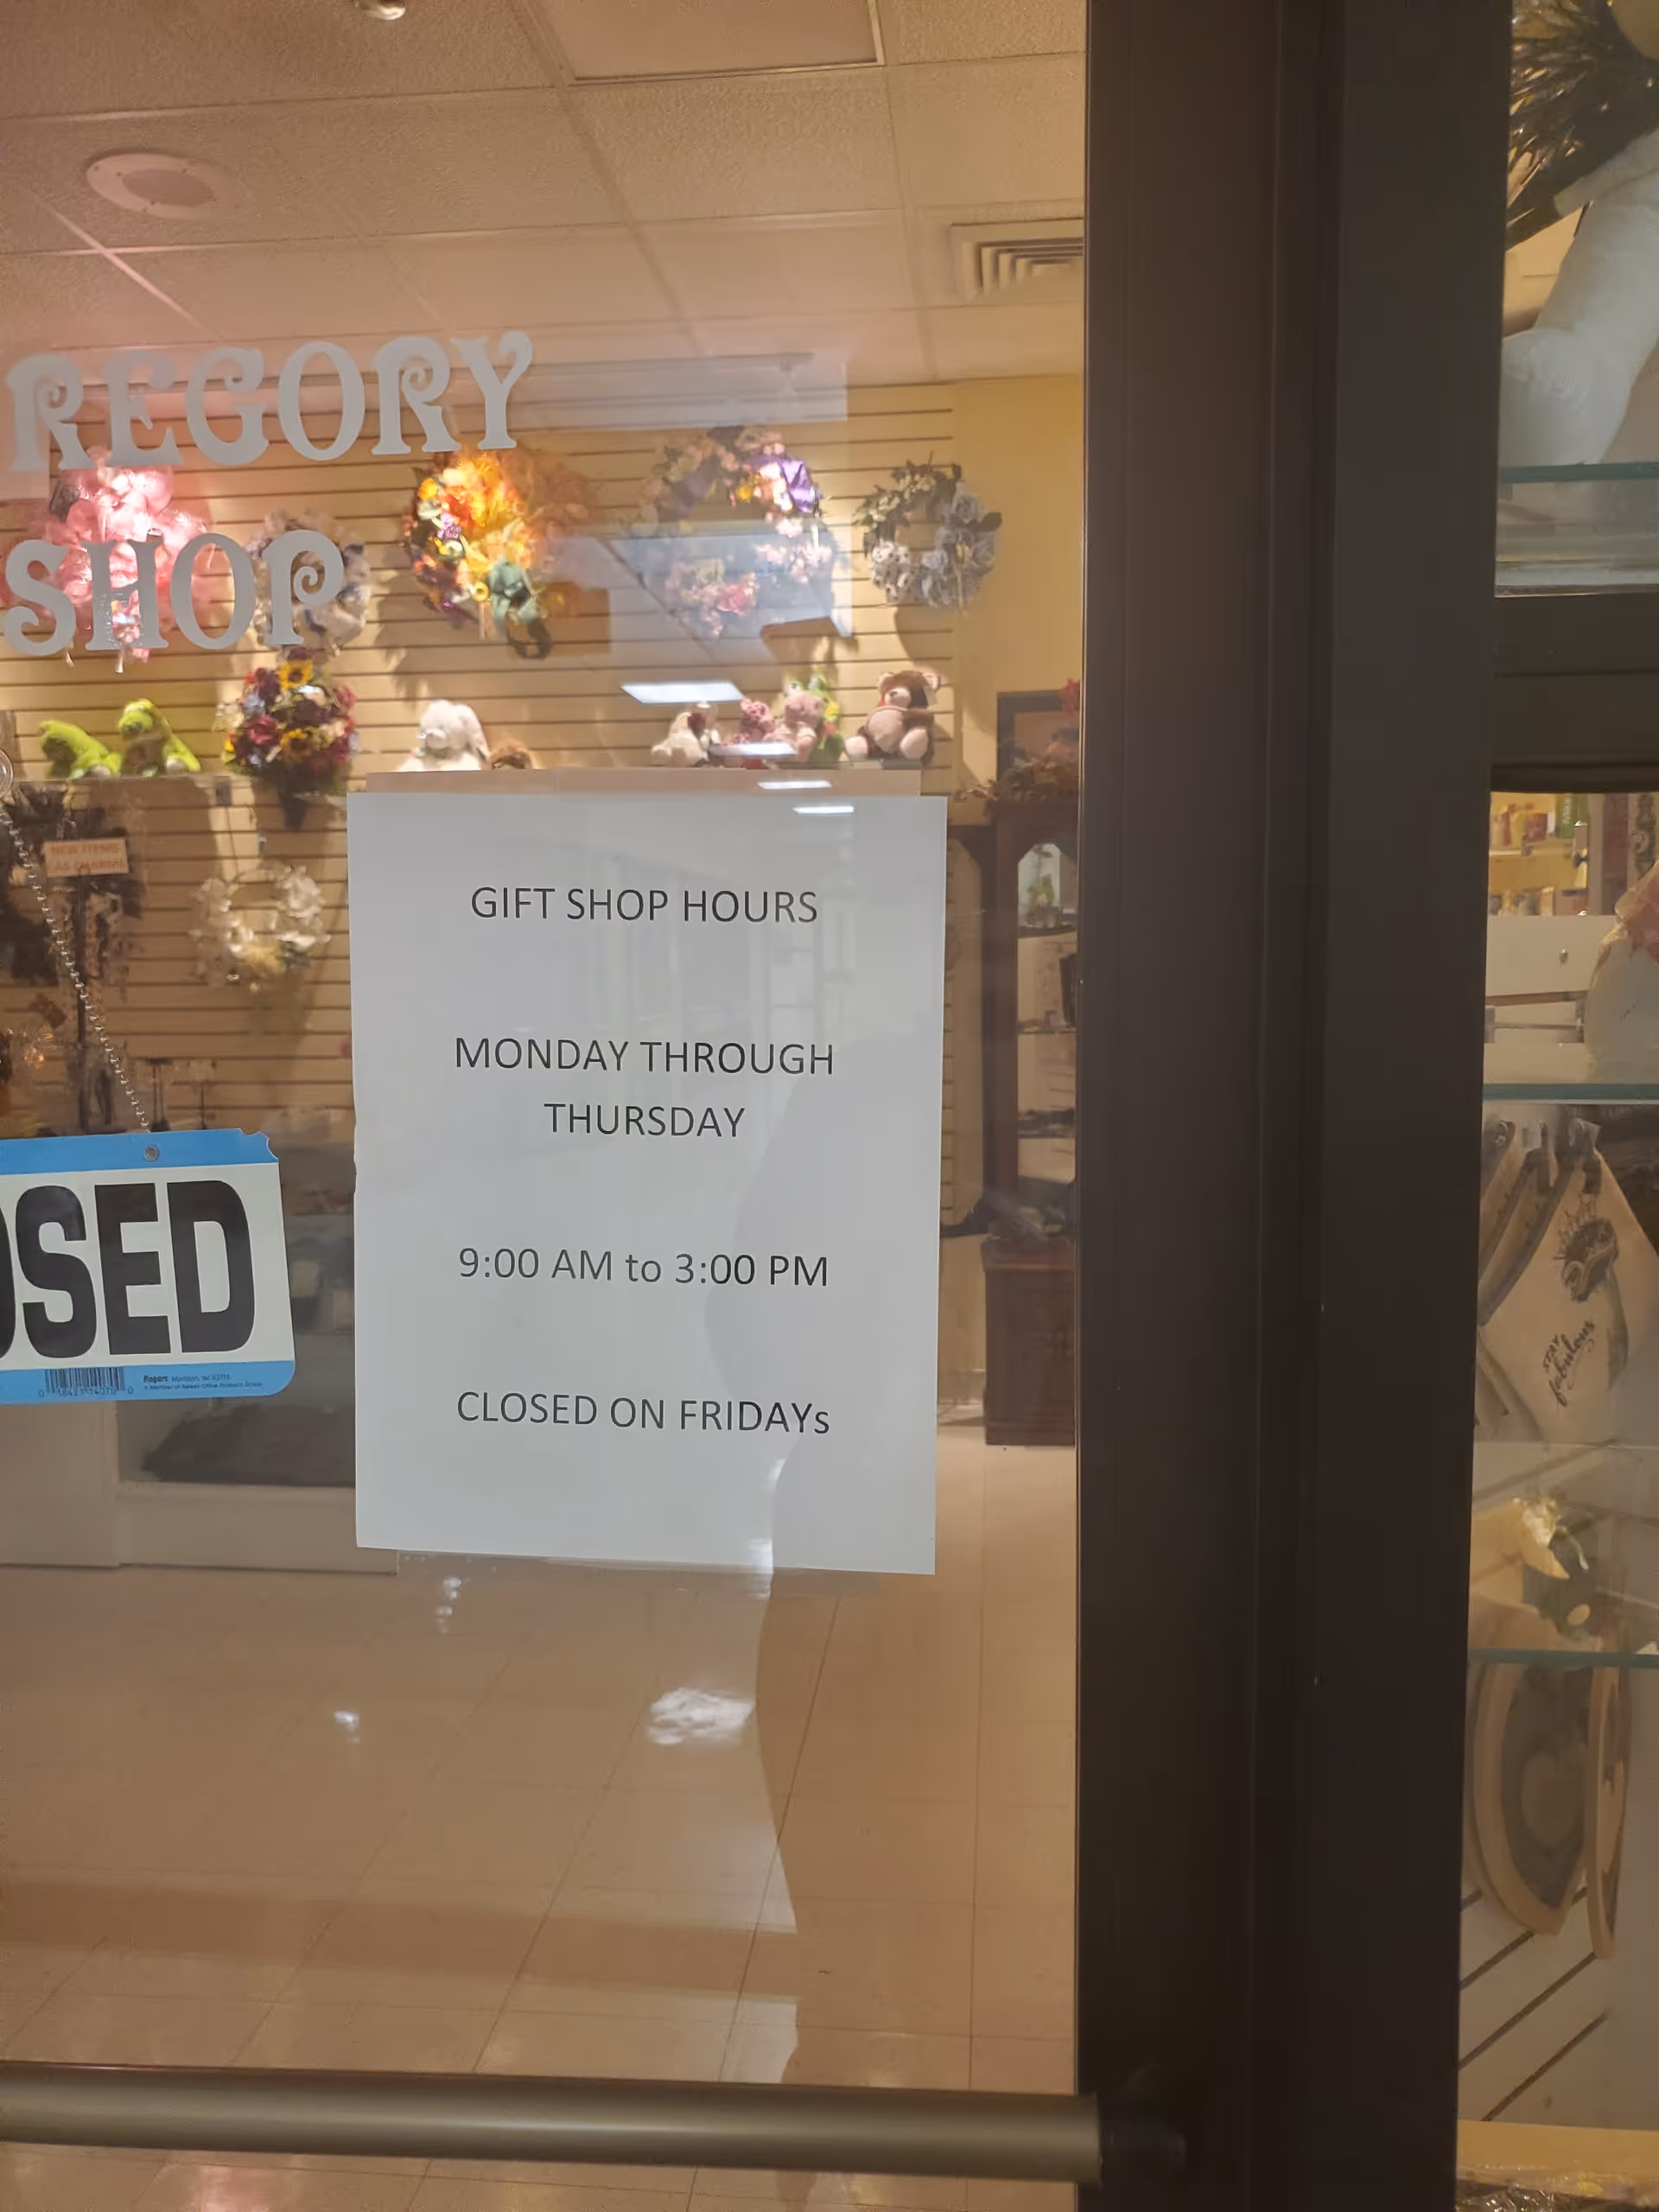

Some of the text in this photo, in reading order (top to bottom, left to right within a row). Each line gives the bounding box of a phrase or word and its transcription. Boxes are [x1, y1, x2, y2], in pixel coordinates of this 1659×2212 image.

[6, 330, 533, 471] REGORY
[3, 529, 345, 657] SHOP
[471, 887, 818, 923] GIFT SHOP HOURS
[455, 1037, 834, 1075] MONDAY THROUGH
[543, 1103, 746, 1138] THURSDAY
[0, 1180, 256, 1358] SED
[459, 1248, 828, 1287] 9:00 AM to 3:00 PM
[457, 1391, 830, 1434] CLOSED ON FRIDAYs
